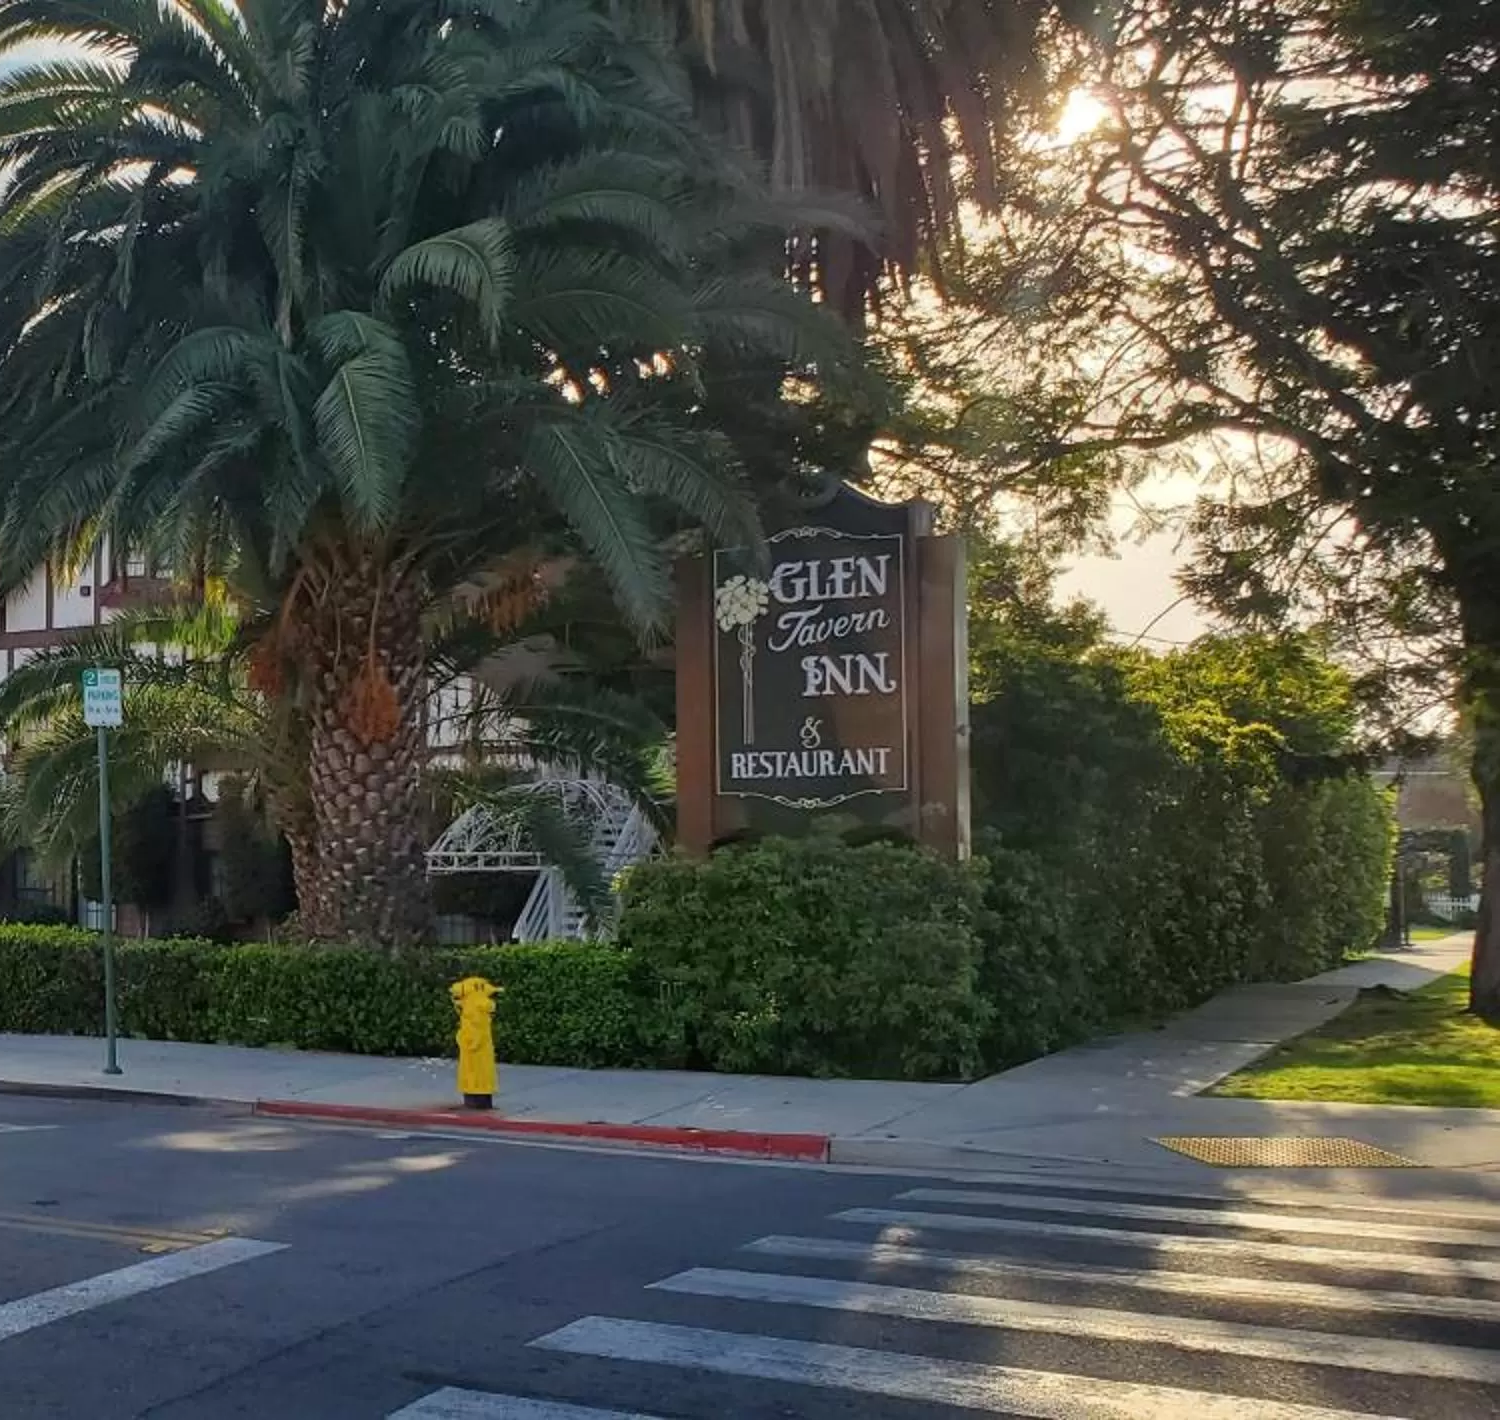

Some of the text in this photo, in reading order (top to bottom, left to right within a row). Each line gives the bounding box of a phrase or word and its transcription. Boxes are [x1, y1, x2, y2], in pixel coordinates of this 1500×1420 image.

[768, 554, 891, 604] GLEN
[767, 603, 890, 652] Tavern
[801, 652, 897, 697] INN
[799, 716, 822, 749] &
[731, 747, 892, 780] RESTAURANT
